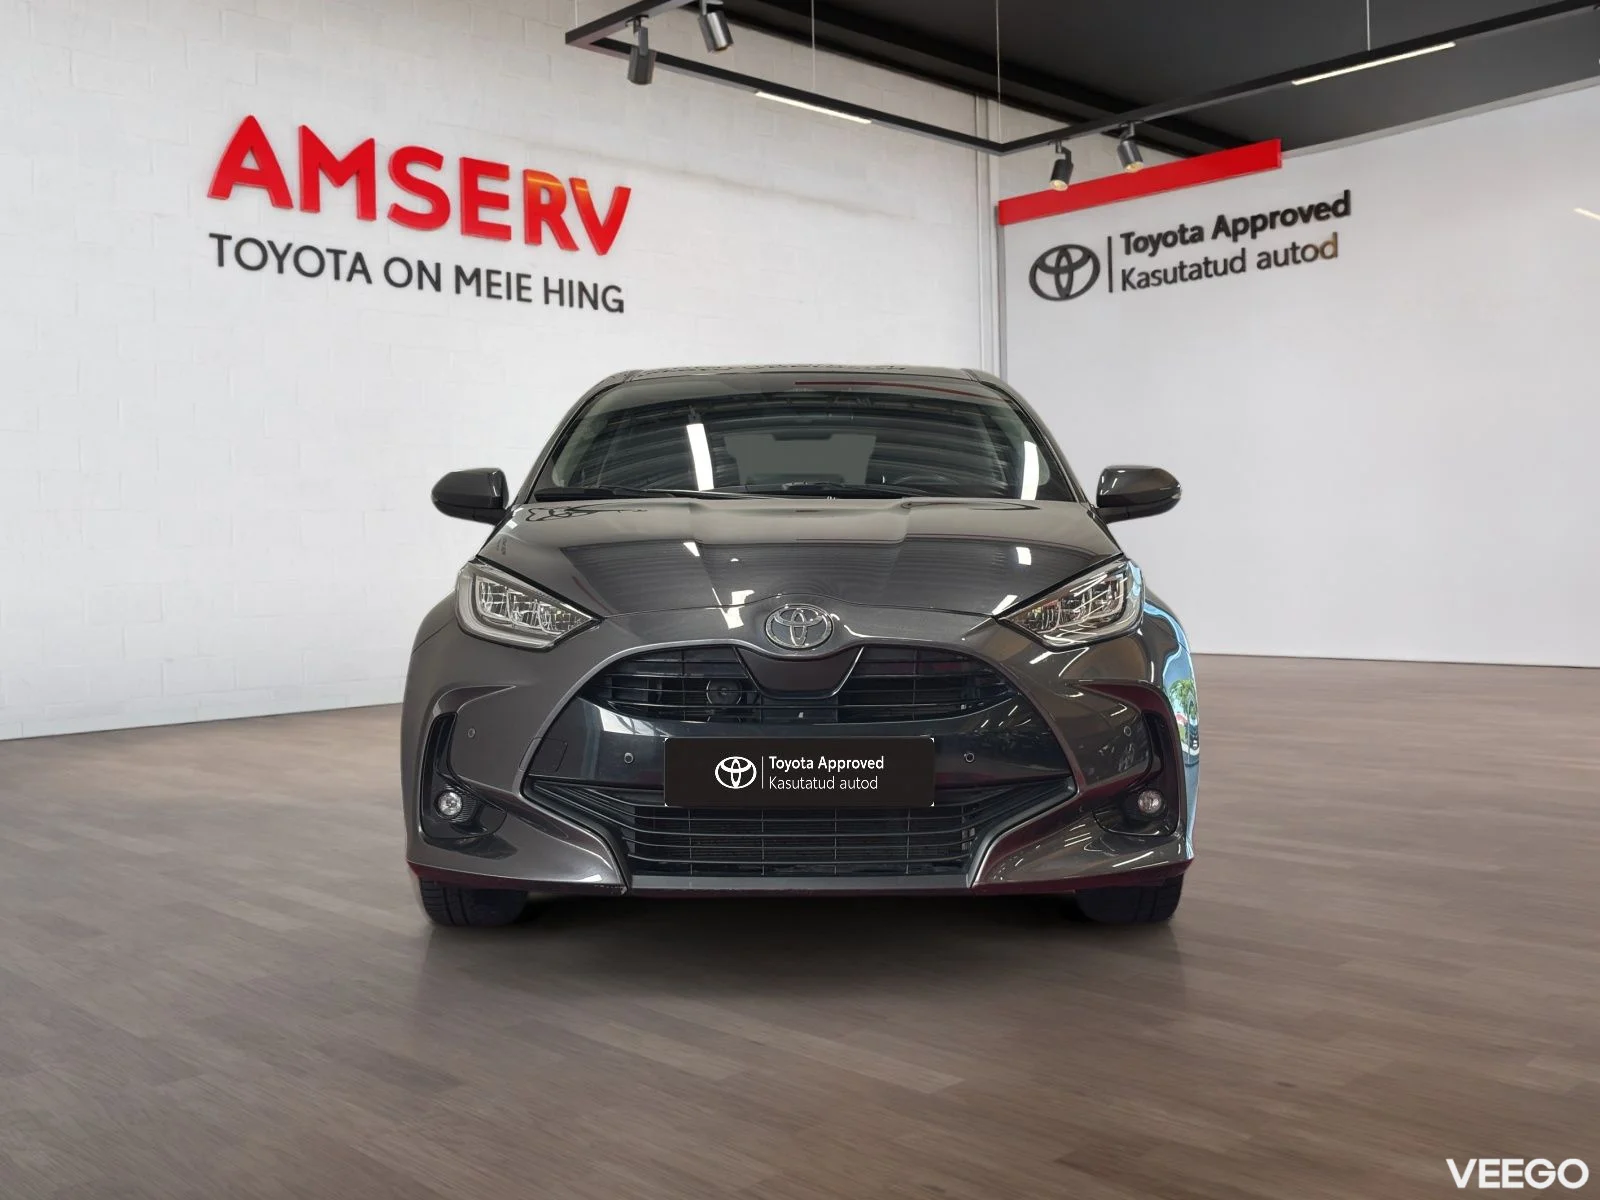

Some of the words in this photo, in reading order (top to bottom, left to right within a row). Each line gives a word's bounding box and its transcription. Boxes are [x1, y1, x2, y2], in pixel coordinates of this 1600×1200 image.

[207, 114, 631, 256] AMSERV
[1120, 223, 1204, 257] Toyota
[1211, 189, 1351, 243] Approved
[209, 233, 372, 284] TOYOTA
[383, 257, 441, 292] ON
[455, 265, 532, 303] MEIE
[544, 276, 624, 313] HING
[1121, 248, 1246, 291] Kasutatud
[1256, 232, 1338, 269] autod
[769, 756, 814, 772] Toyota
[818, 755, 884, 772] Approved
[769, 776, 835, 790] Kasutatud
[839, 776, 878, 790] autod
